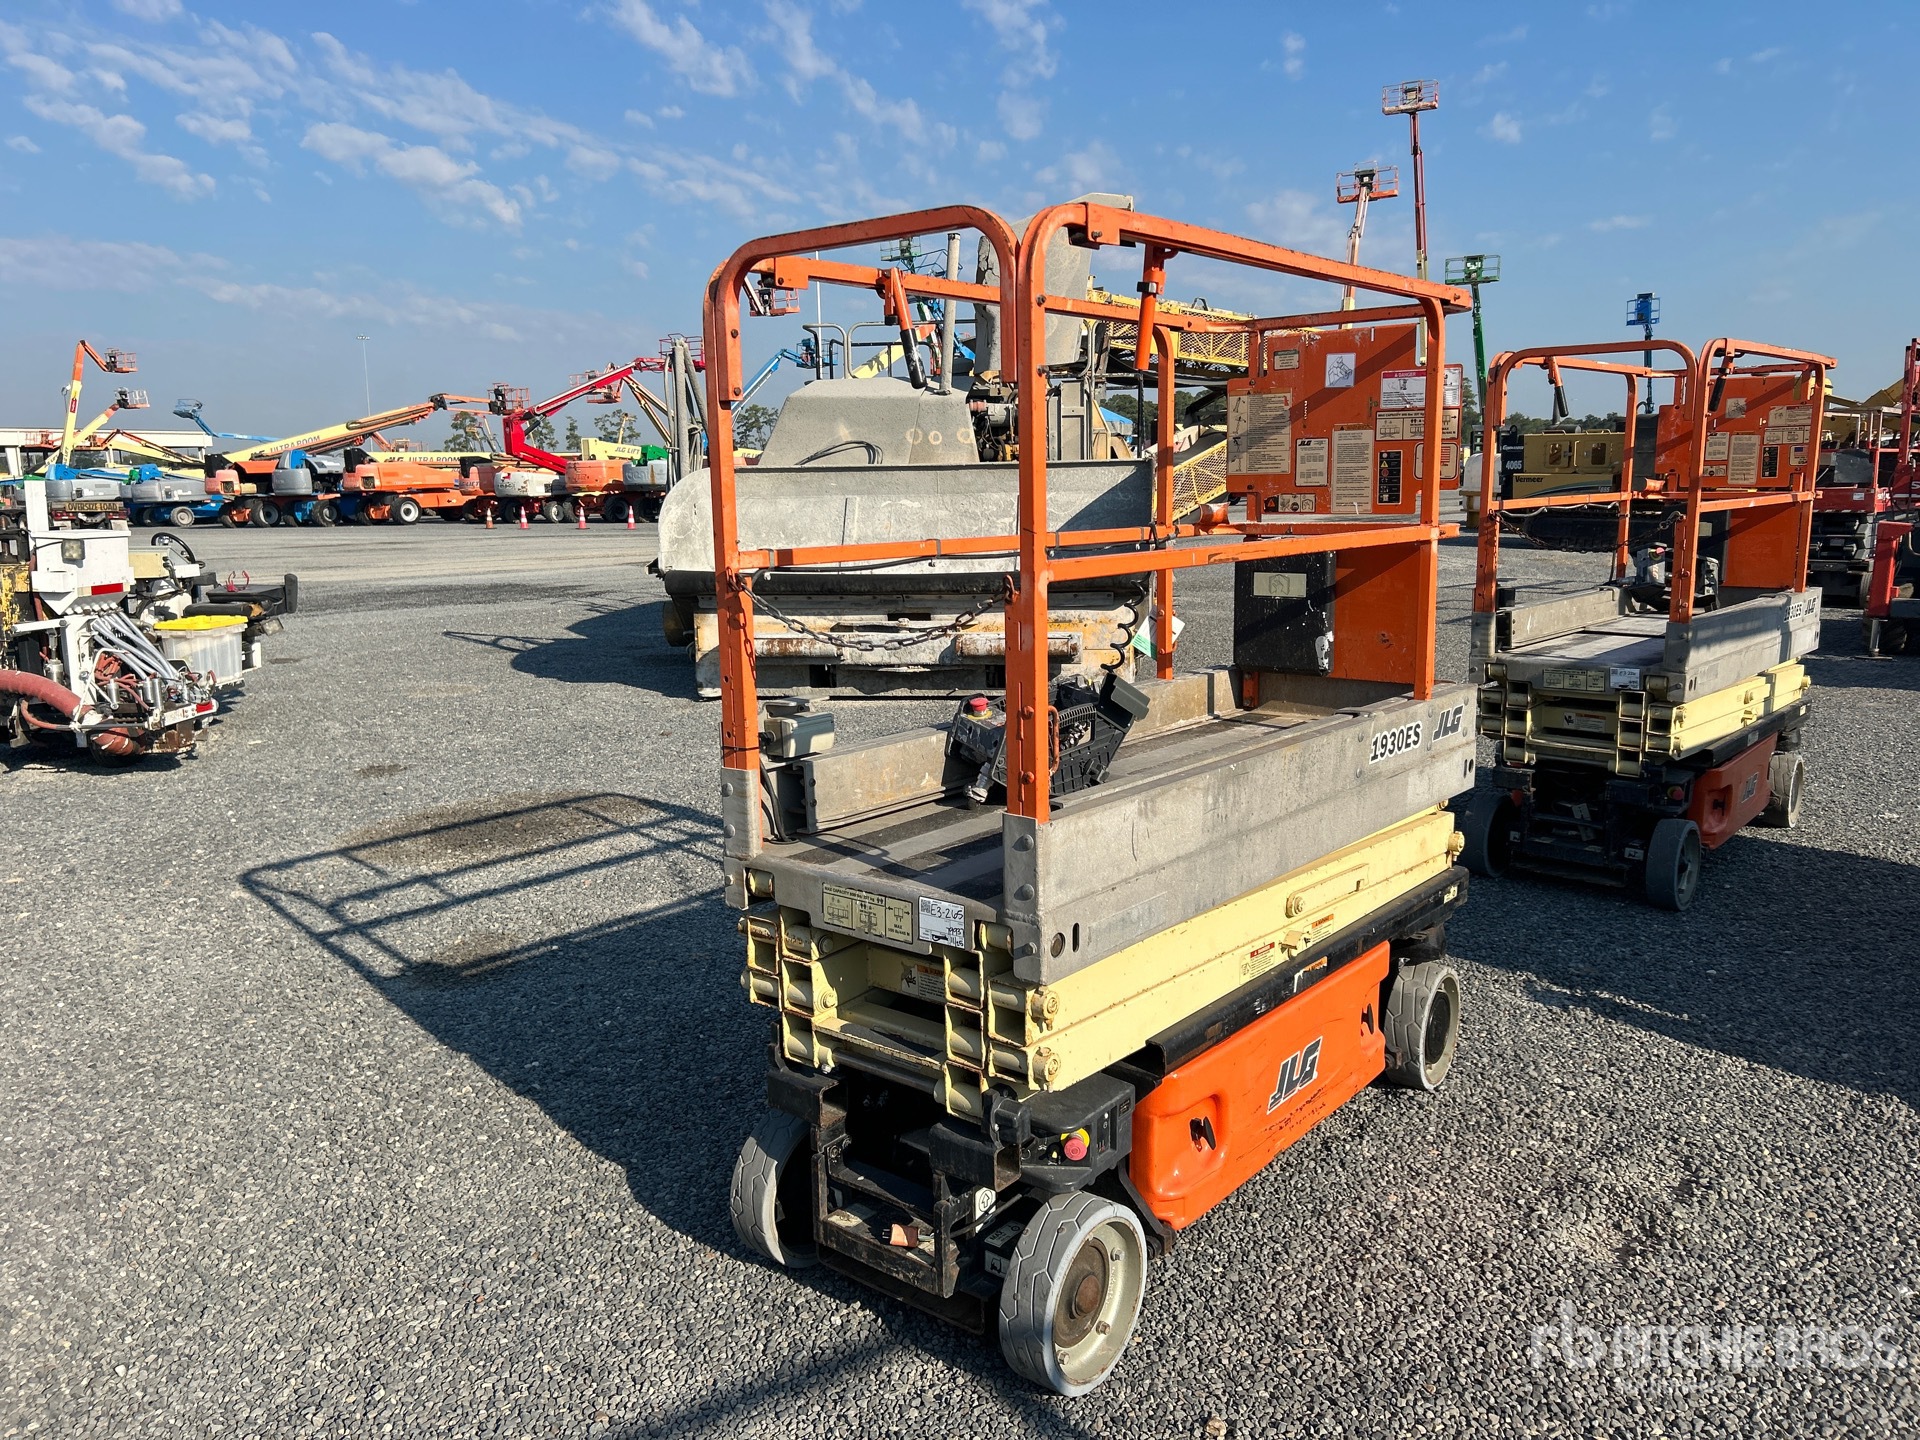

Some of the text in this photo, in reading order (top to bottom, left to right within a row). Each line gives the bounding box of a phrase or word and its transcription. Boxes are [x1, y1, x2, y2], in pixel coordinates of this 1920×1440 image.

[627, 447, 641, 455] LIFT
[1515, 474, 1543, 483] Vermeer
[67, 502, 118, 511] OVERSIZE LOAD
[1370, 704, 1464, 762] 1930ES JLG
[931, 903, 964, 920] E3-265
[1267, 1036, 1322, 1114] JLG
